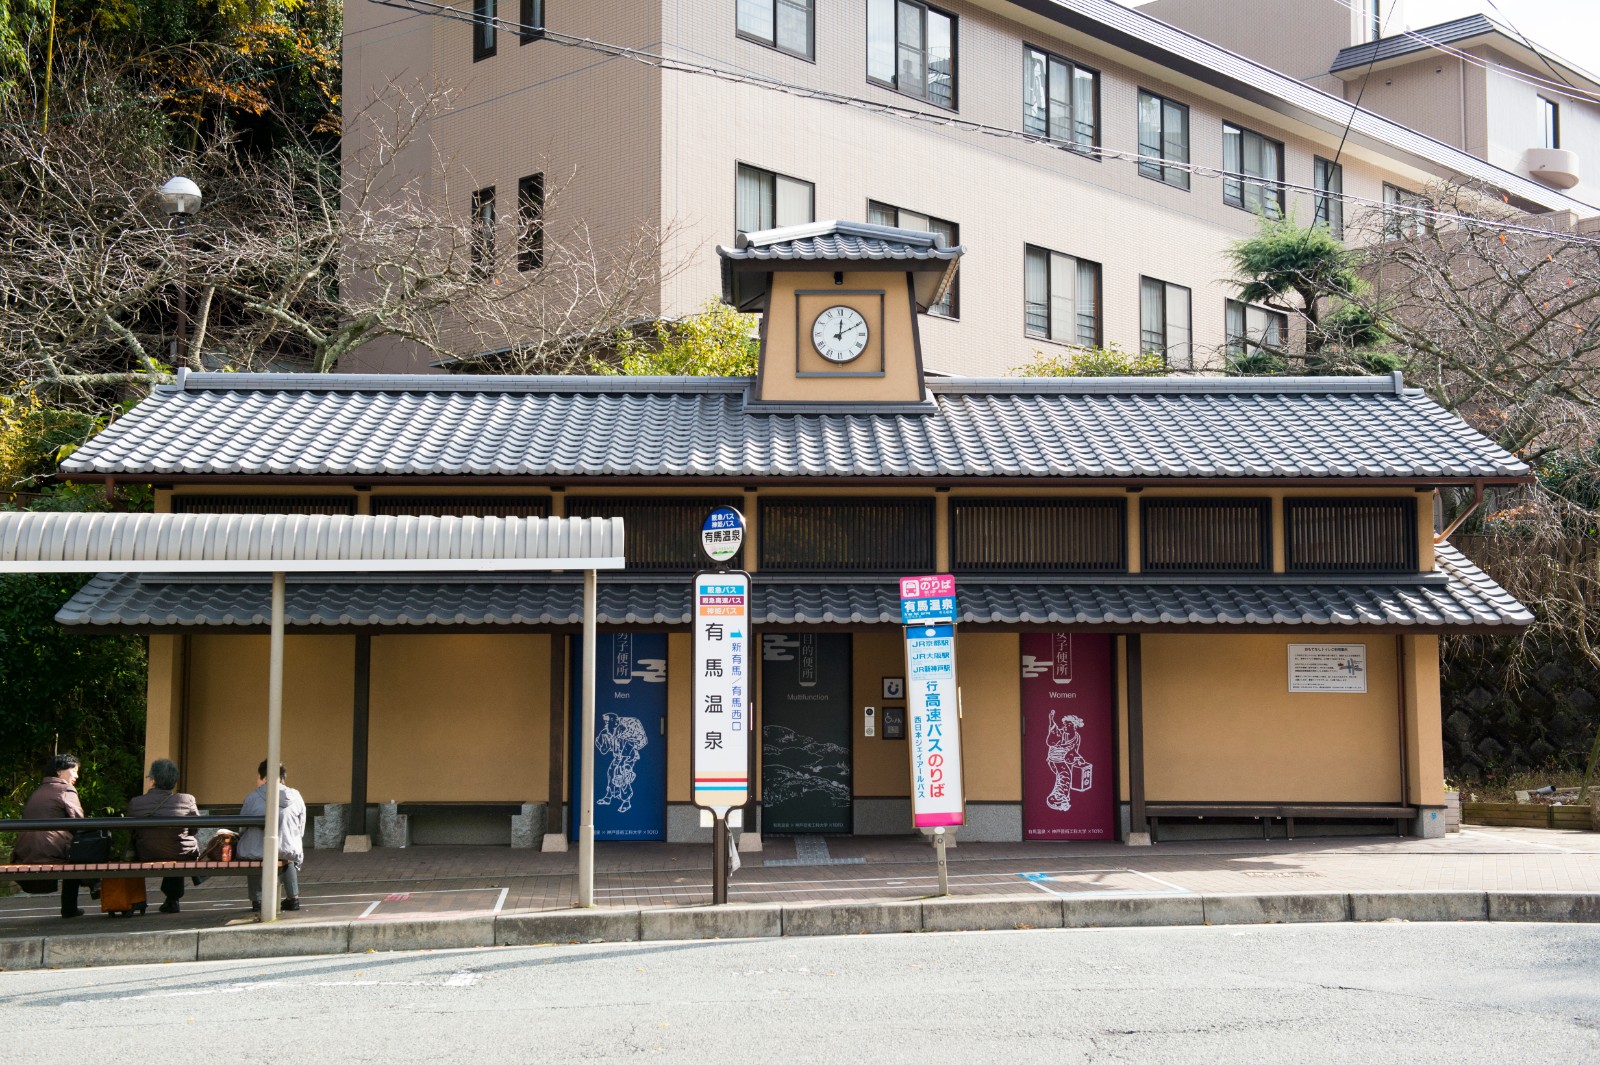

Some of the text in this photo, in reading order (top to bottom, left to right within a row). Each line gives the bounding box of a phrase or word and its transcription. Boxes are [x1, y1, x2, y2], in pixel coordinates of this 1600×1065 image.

[704, 530, 740, 543] 有馬温泉
[920, 580, 952, 590] のりば
[904, 599, 953, 612] 有馬温泉
[913, 664, 950, 673] JR新神戸駅
[704, 622, 724, 750] 有馬温泉
[914, 716, 925, 798] 西日本ジェイアールバス
